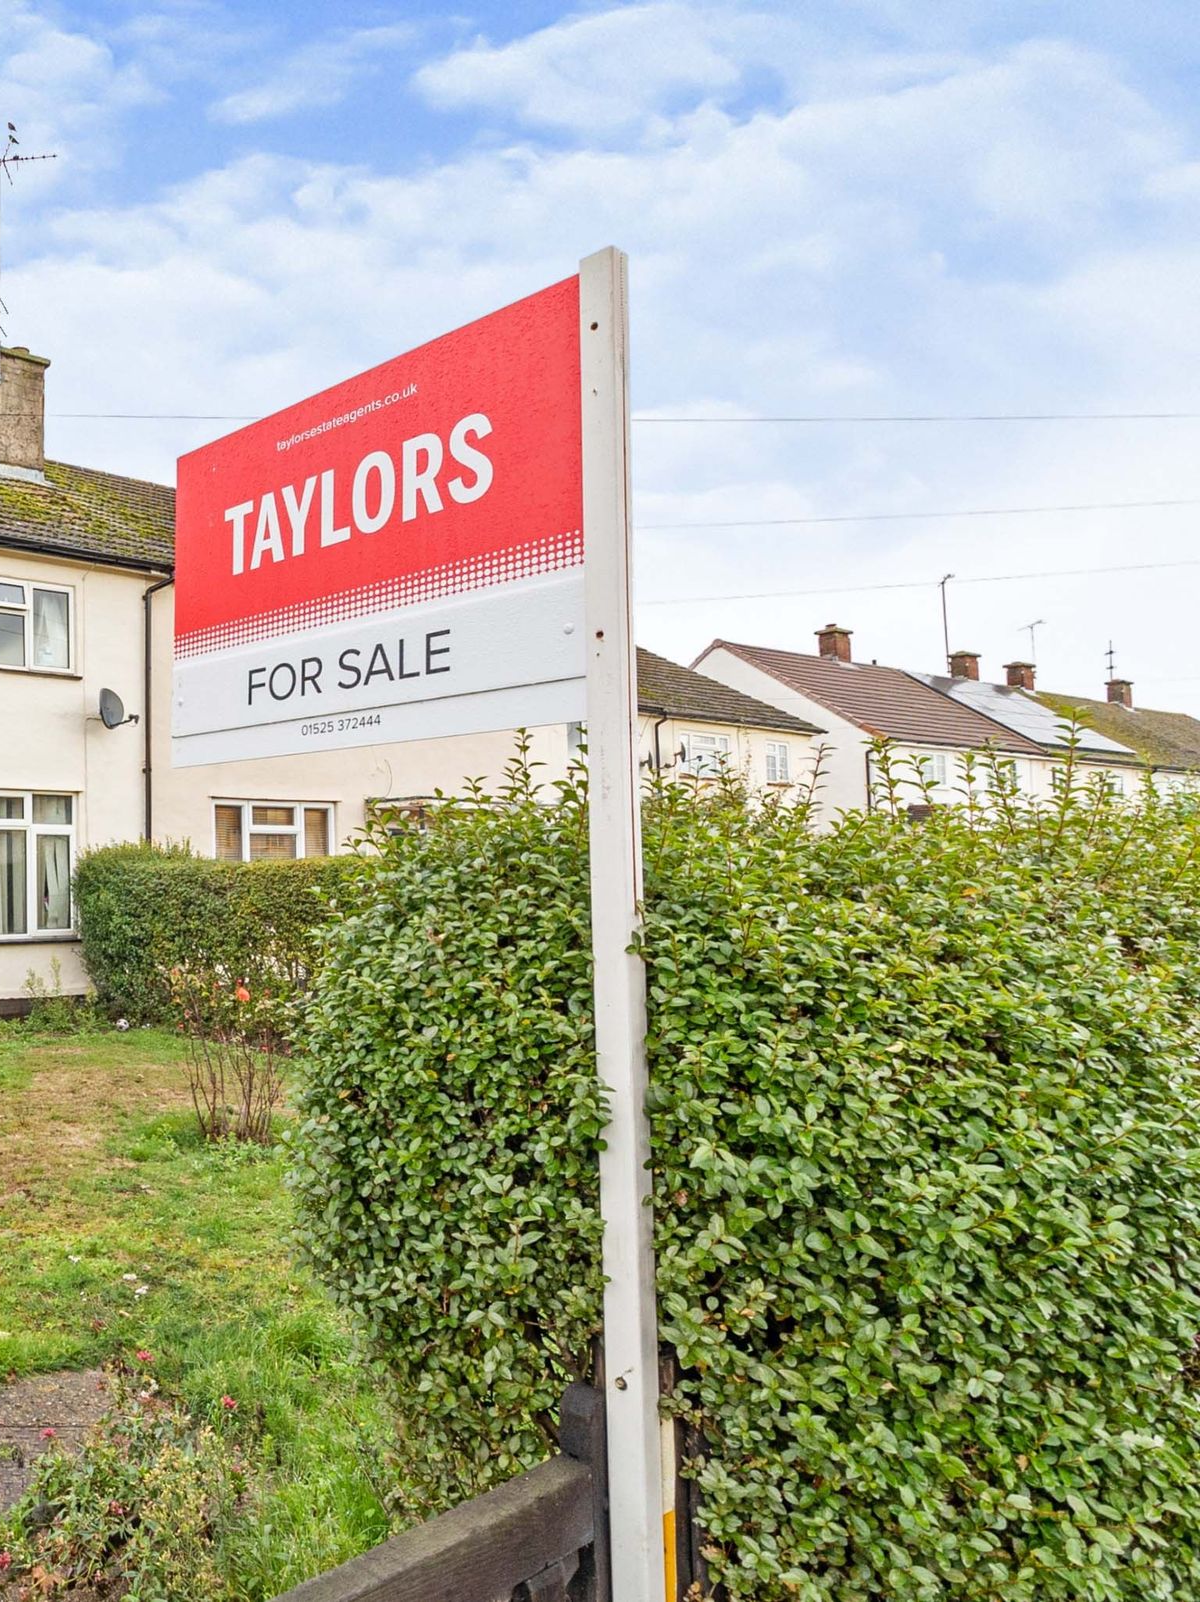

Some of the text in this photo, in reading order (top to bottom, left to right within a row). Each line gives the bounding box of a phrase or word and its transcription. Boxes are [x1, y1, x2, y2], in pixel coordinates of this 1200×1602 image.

[276, 383, 418, 452] taylorsestateagents.co.uk
[224, 413, 494, 576] TAYLORS
[247, 629, 451, 705] FOR SALE
[301, 714, 381, 736] 01525 372444
